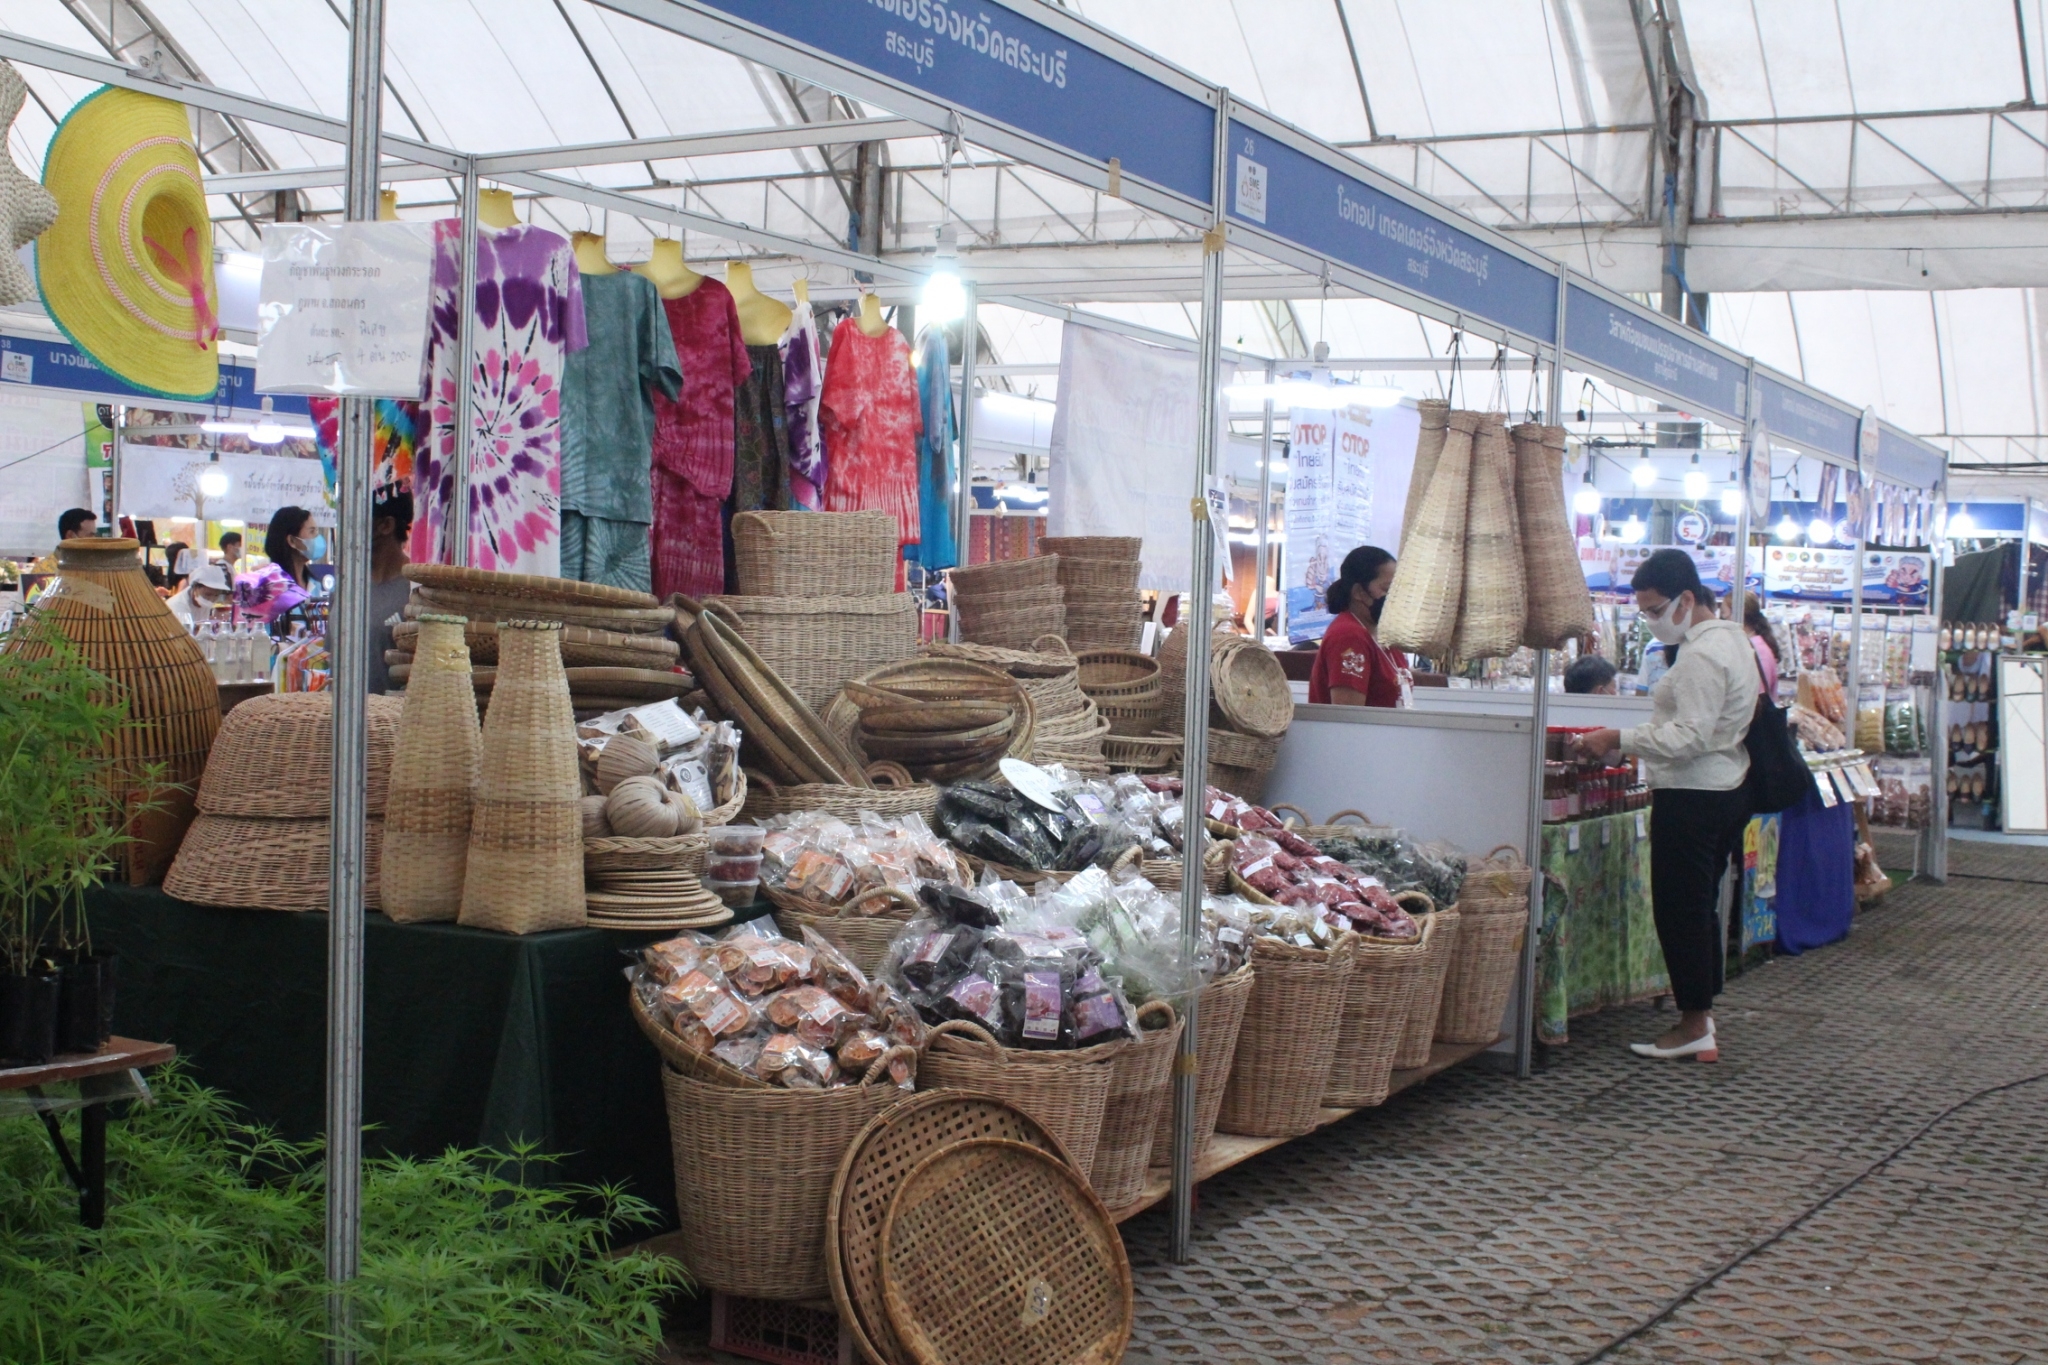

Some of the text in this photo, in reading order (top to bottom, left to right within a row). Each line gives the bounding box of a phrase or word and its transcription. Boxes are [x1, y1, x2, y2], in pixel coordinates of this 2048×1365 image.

[886, 30, 934, 75] สระบุรี
[1244, 137, 1255, 156] 26
[1337, 184, 1375, 231] โอทอป
[1407, 258, 1429, 283] สระบุรี
[1, 339, 11, 349] 38
[1294, 424, 1326, 446] OTOP
[1342, 432, 1370, 458] OTOP
